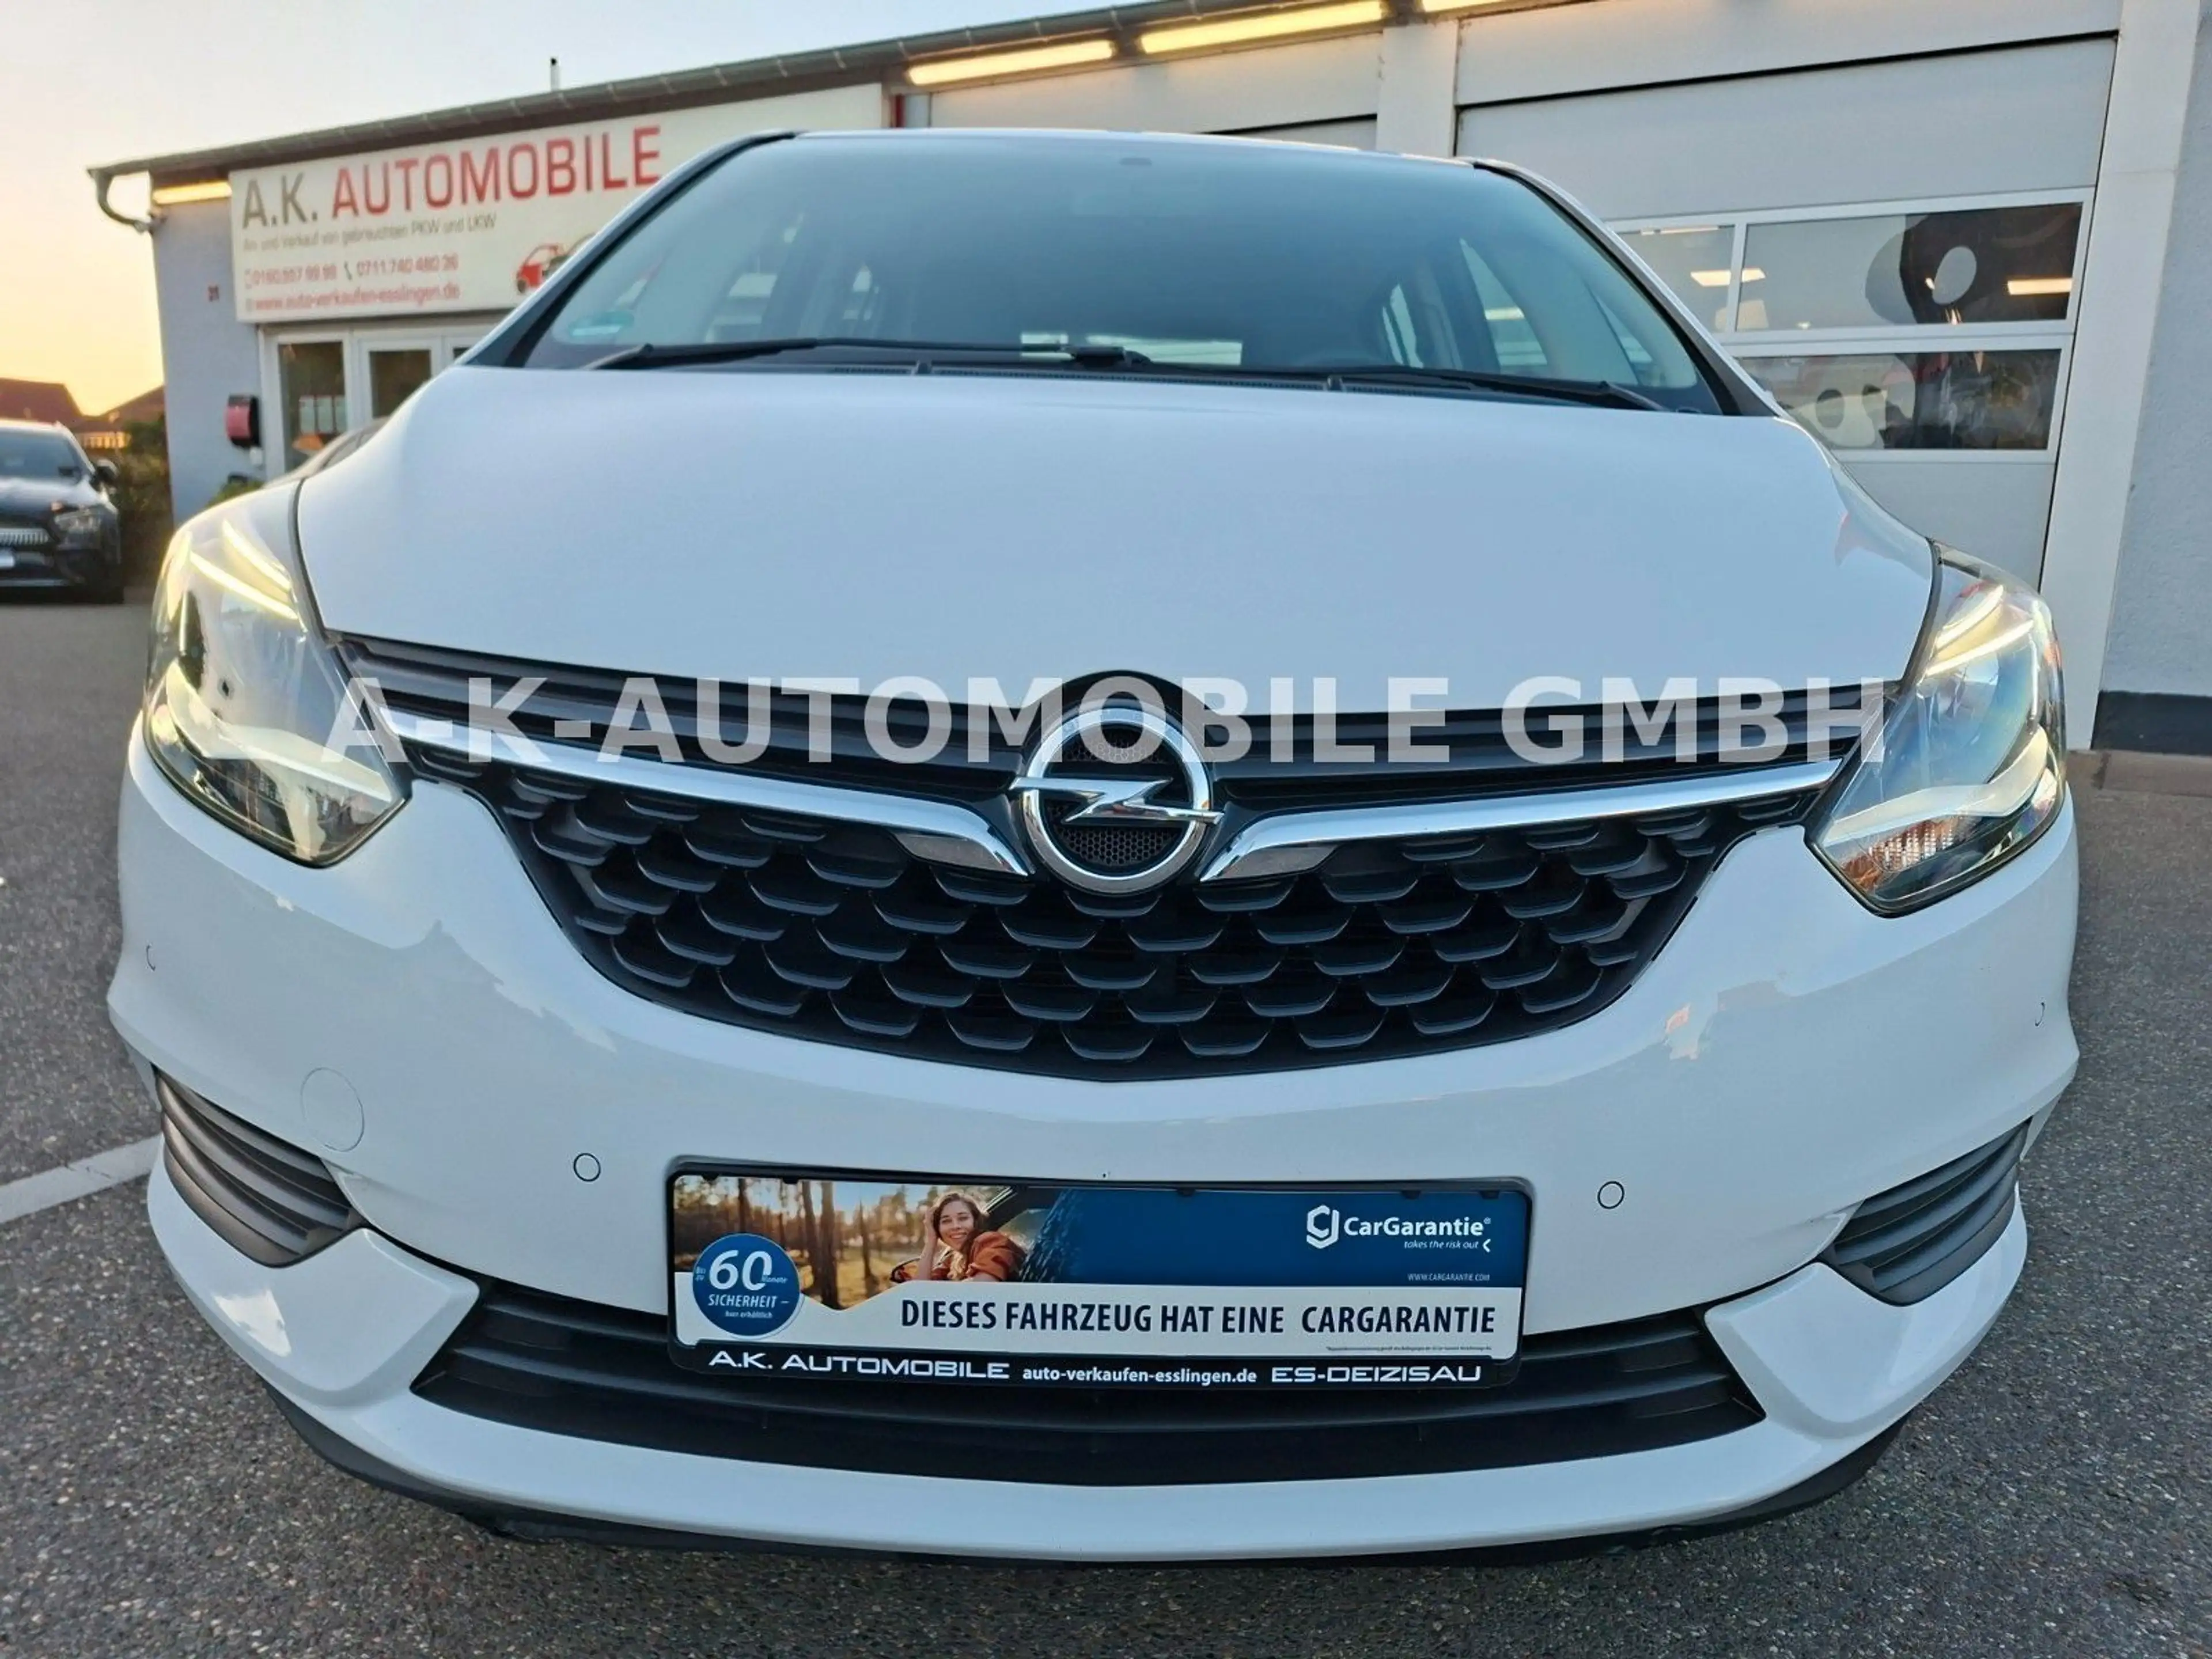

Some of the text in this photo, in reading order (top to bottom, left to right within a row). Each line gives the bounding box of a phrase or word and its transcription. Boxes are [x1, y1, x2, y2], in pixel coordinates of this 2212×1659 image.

[242, 126, 662, 229] A.K. AUTOMOBILE
[411, 217, 440, 234] PKW
[443, 217, 464, 234] und
[468, 211, 497, 232] LKW
[1343, 1217, 1484, 1236] CarGarantie
[1404, 1240, 1427, 1249] takes
[1429, 1240, 1445, 1249] the
[1446, 1240, 1461, 1249] risk
[709, 1249, 772, 1291] 60
[708, 1294, 777, 1309] SICHERHEIT
[902, 1300, 1495, 1333] DIESES FAHRZEUG HAT EINE CARGARANTIE
[709, 1350, 1482, 1386] A.K. AUTOMOBILE auto-verkaufen-esslingen.de ES-DEIZISAU
